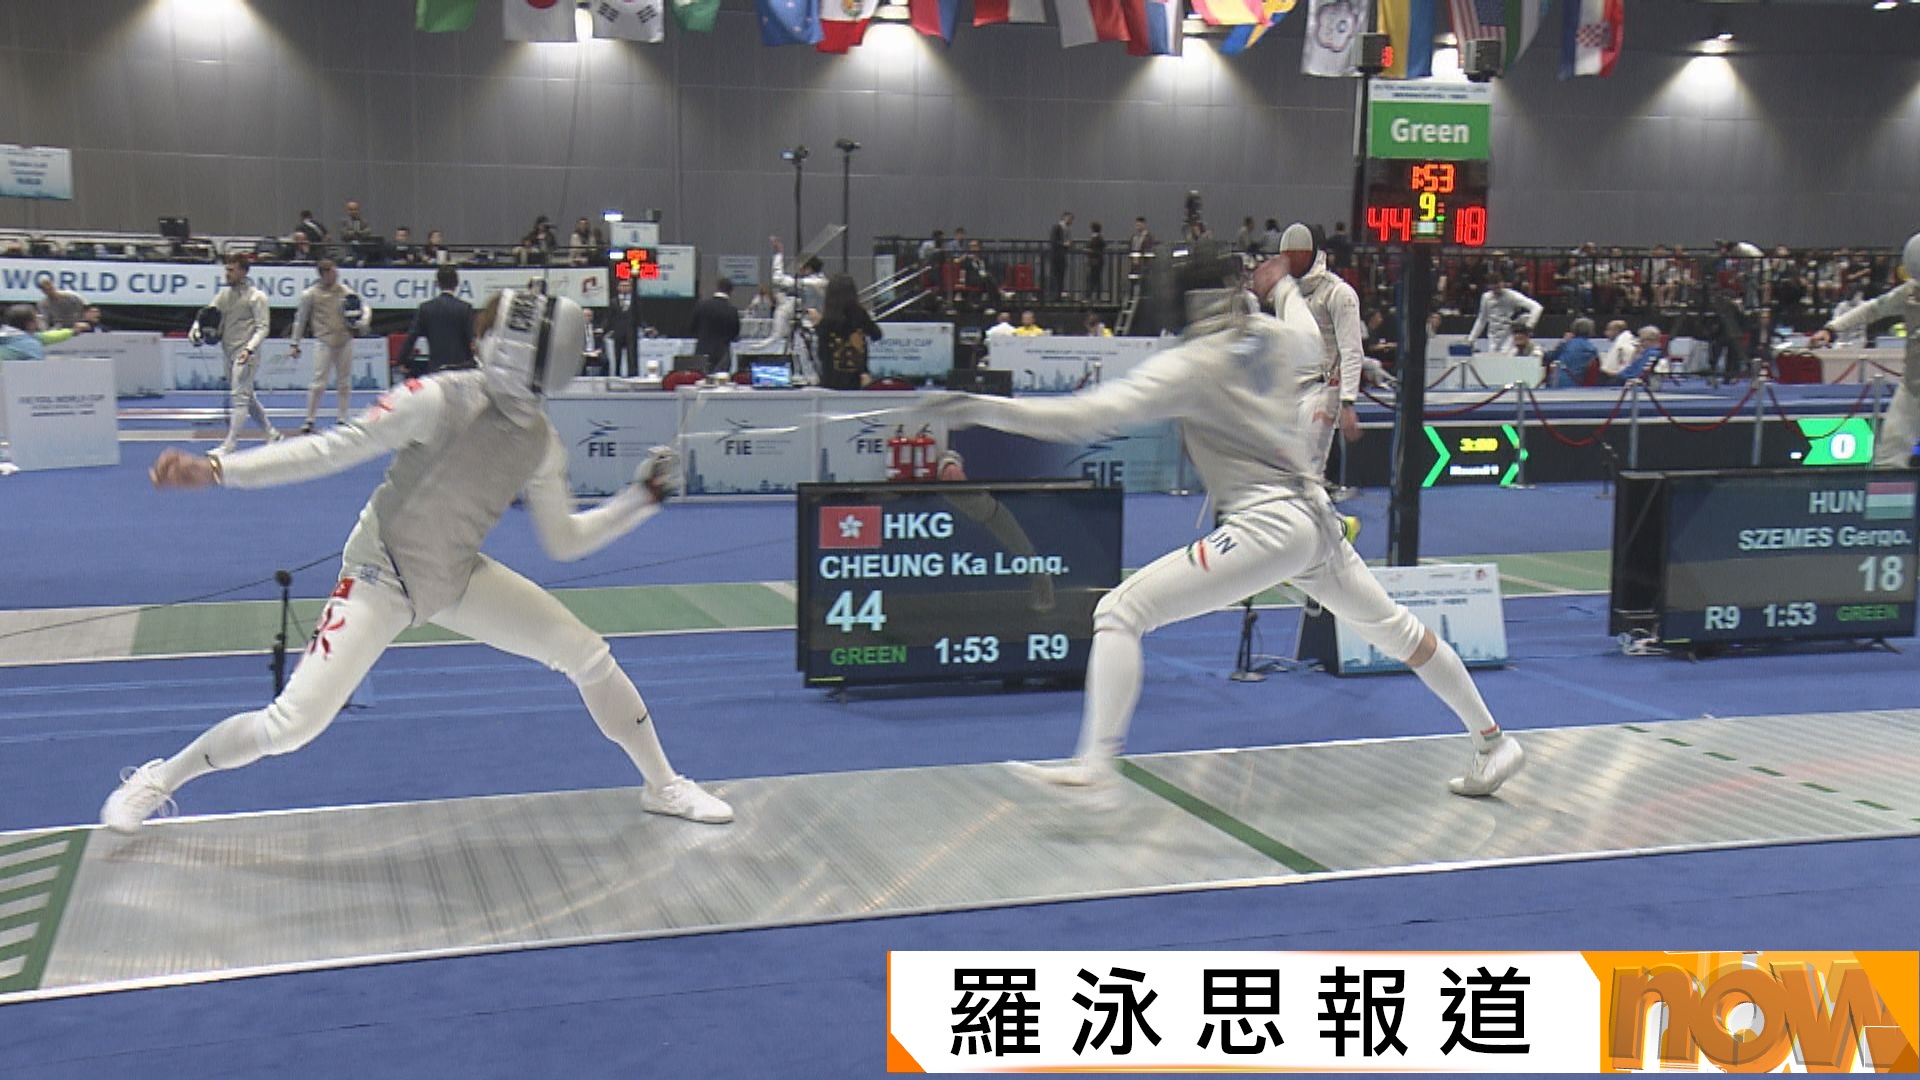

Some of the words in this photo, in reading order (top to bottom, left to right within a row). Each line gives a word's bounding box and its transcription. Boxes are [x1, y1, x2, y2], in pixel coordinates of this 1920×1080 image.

[1390, 117, 1470, 144] Green
[1419, 192, 1436, 221] 9
[1367, 207, 1412, 242] 44
[1455, 205, 1486, 246] 18
[3, 269, 118, 292] WORLD
[128, 273, 188, 293] CUP
[394, 278, 475, 299] CHIA
[588, 442, 617, 457] FIE
[725, 440, 752, 455] FIE
[857, 438, 883, 454] FIE
[1809, 490, 1864, 514] HUN
[884, 512, 954, 539] HKG
[1738, 527, 1833, 550] SZEMES
[819, 553, 945, 579] CHEUNG
[952, 553, 988, 575] Ka
[995, 552, 1070, 576] Long.
[1858, 555, 1904, 592] 18
[825, 590, 887, 632] 44
[1704, 606, 1741, 630] R9
[1763, 602, 1817, 627] 1:53
[1836, 604, 1899, 622] GREEN
[830, 646, 907, 666] GREEN
[934, 636, 999, 664] 1:53
[1027, 634, 1070, 661] R9
